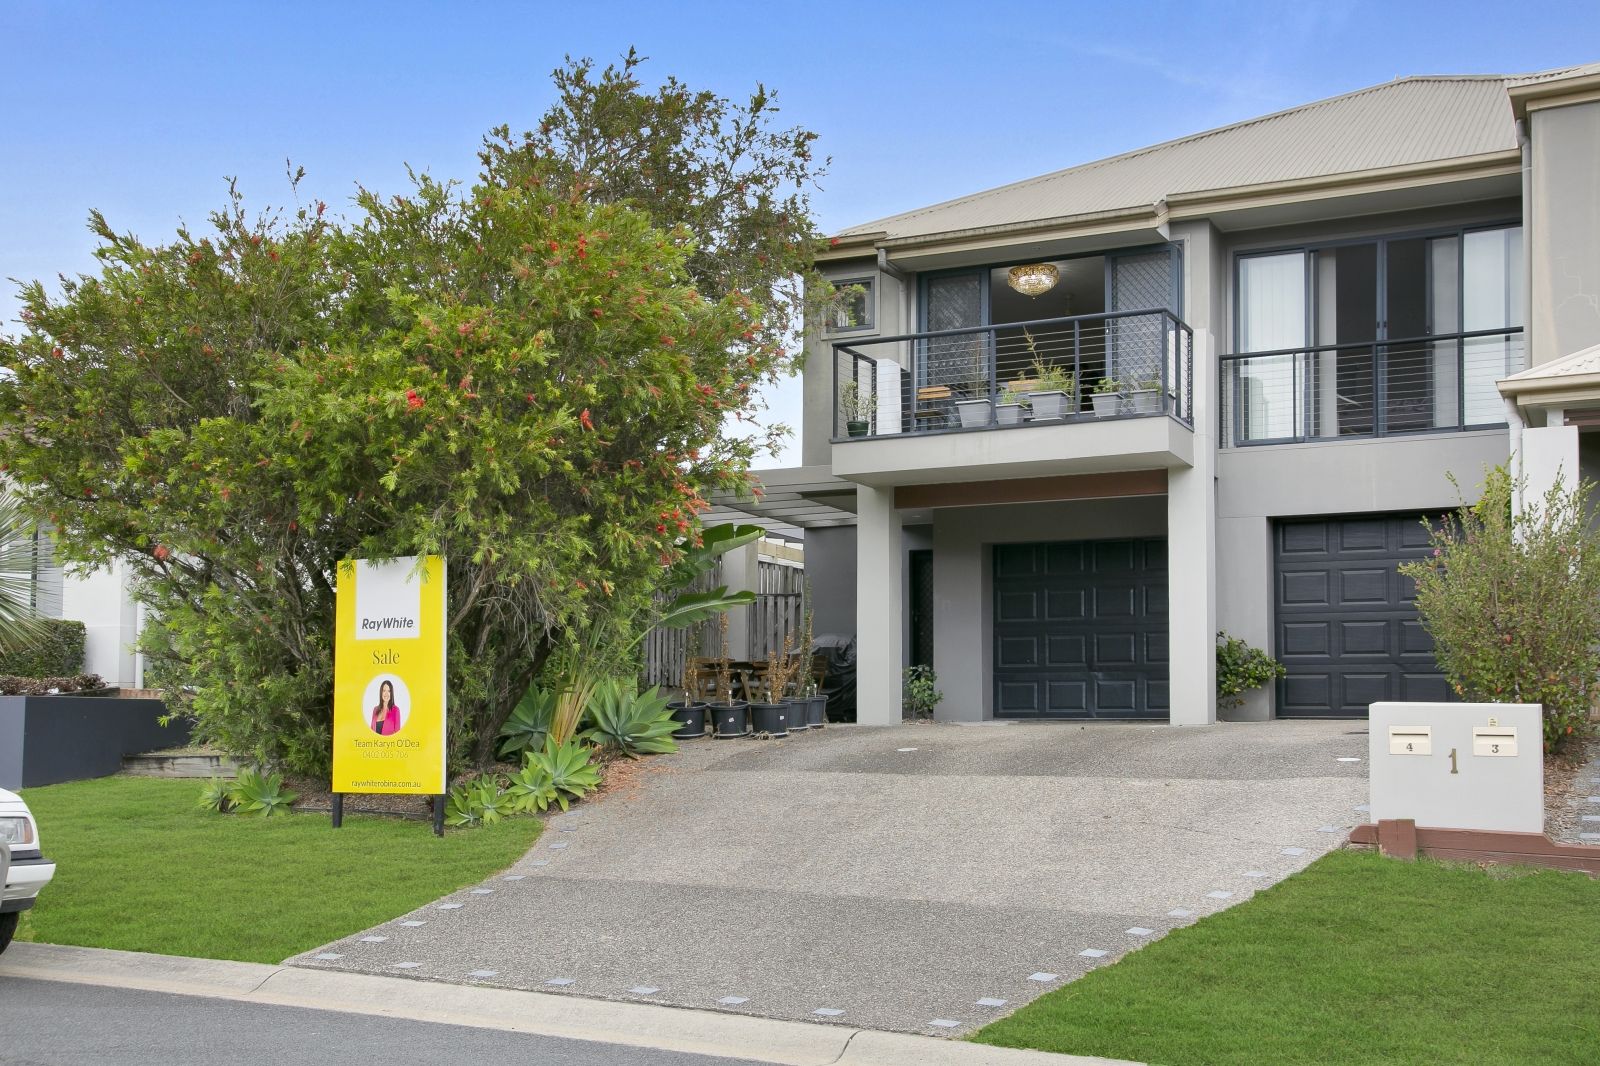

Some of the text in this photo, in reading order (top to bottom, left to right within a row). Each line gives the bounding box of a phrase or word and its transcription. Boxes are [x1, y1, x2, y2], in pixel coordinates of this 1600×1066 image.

[362, 617, 414, 631] RayWhite
[373, 649, 400, 665] Sale
[354, 739, 420, 749] Team Karyn O'Dea
[1406, 743, 1413, 751] 4
[1492, 744, 1499, 753] 3
[1448, 748, 1459, 774] 1
[351, 779, 421, 788] raywhiterobina.com.au
